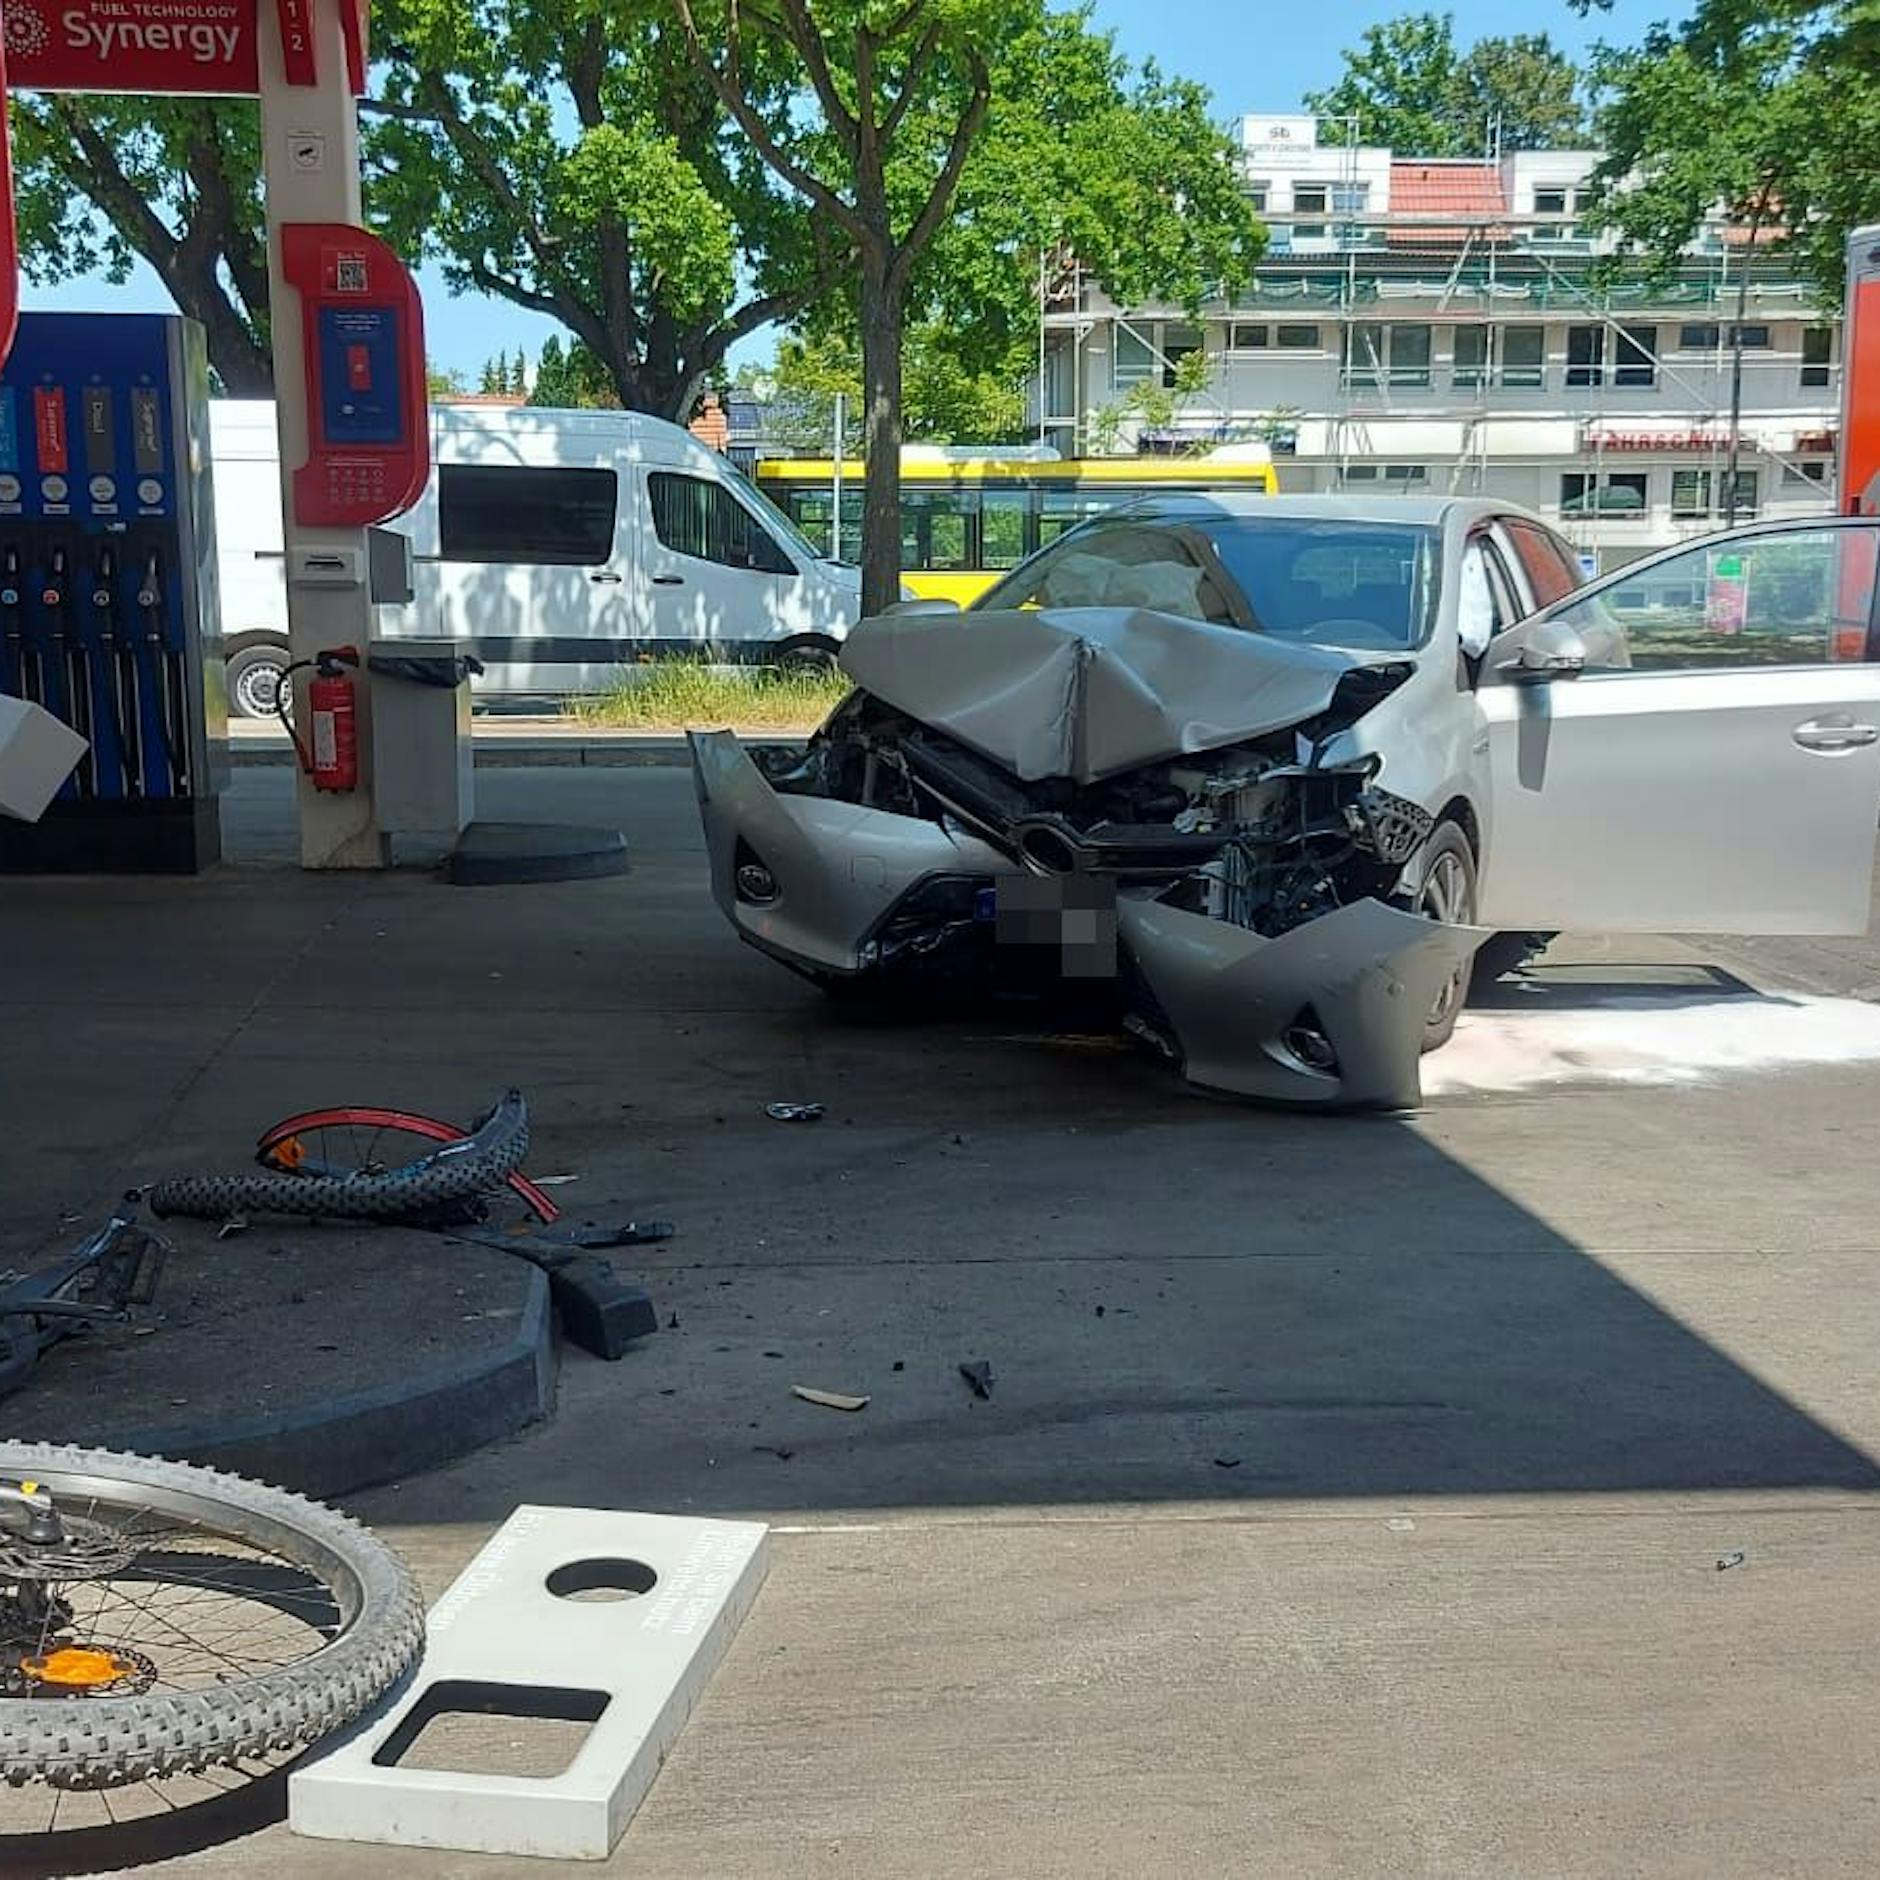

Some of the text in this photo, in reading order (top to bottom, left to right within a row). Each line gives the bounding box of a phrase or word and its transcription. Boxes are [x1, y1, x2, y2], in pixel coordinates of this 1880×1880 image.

[91, 3, 238, 19] FUEL TECHNOLOGY
[287, 1, 297, 18] 1
[63, 11, 240, 62] Synergy
[291, 34, 304, 52] 2
[1592, 429, 1741, 451] FAHRSCHUL
